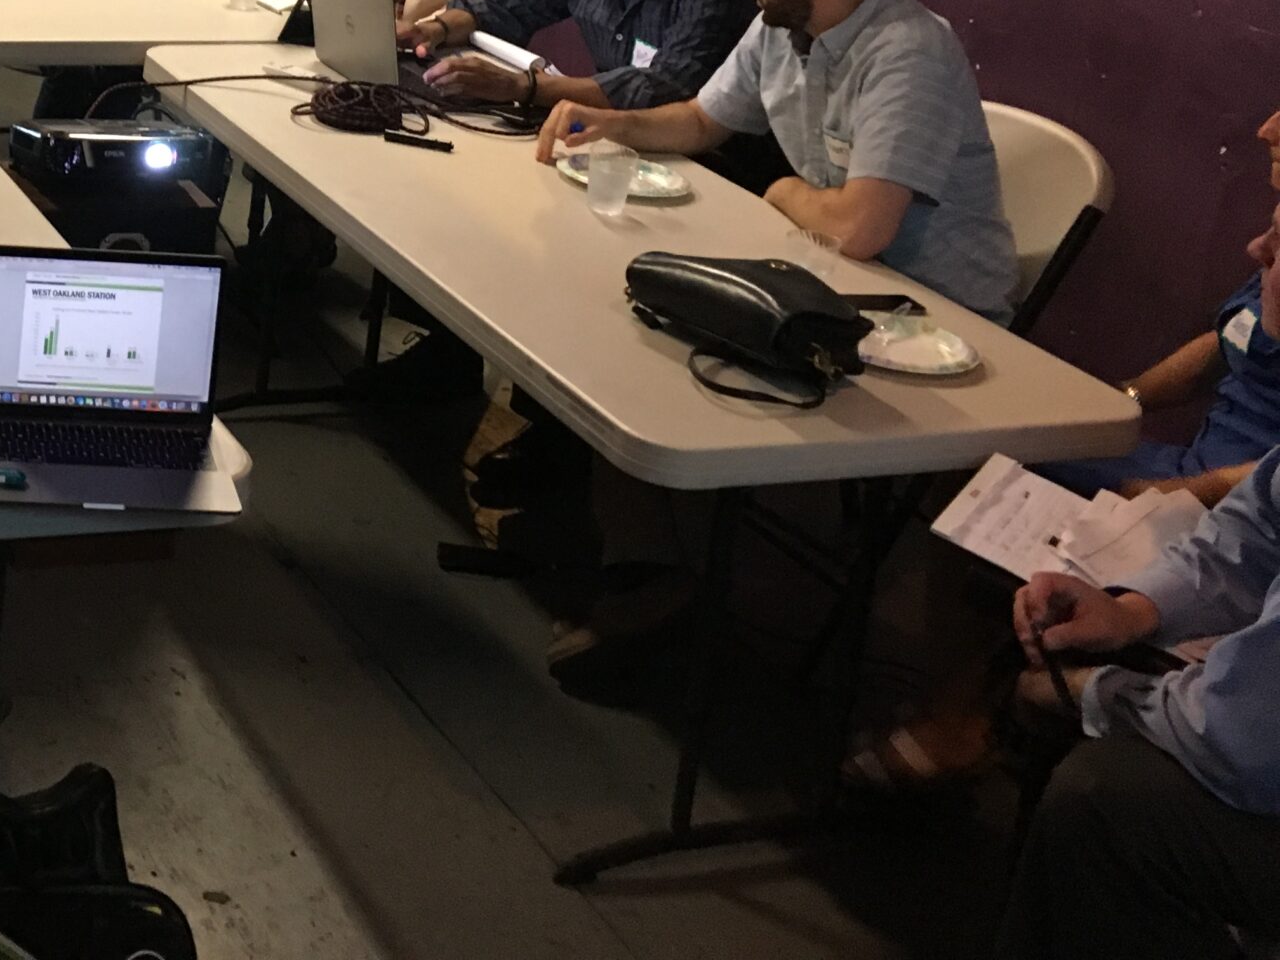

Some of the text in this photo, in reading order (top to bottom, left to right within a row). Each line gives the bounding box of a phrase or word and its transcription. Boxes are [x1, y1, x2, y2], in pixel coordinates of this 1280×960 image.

[32, 289, 51, 297] WEST
[52, 290, 86, 299] OAKLAND
[87, 292, 116, 301] STATION
